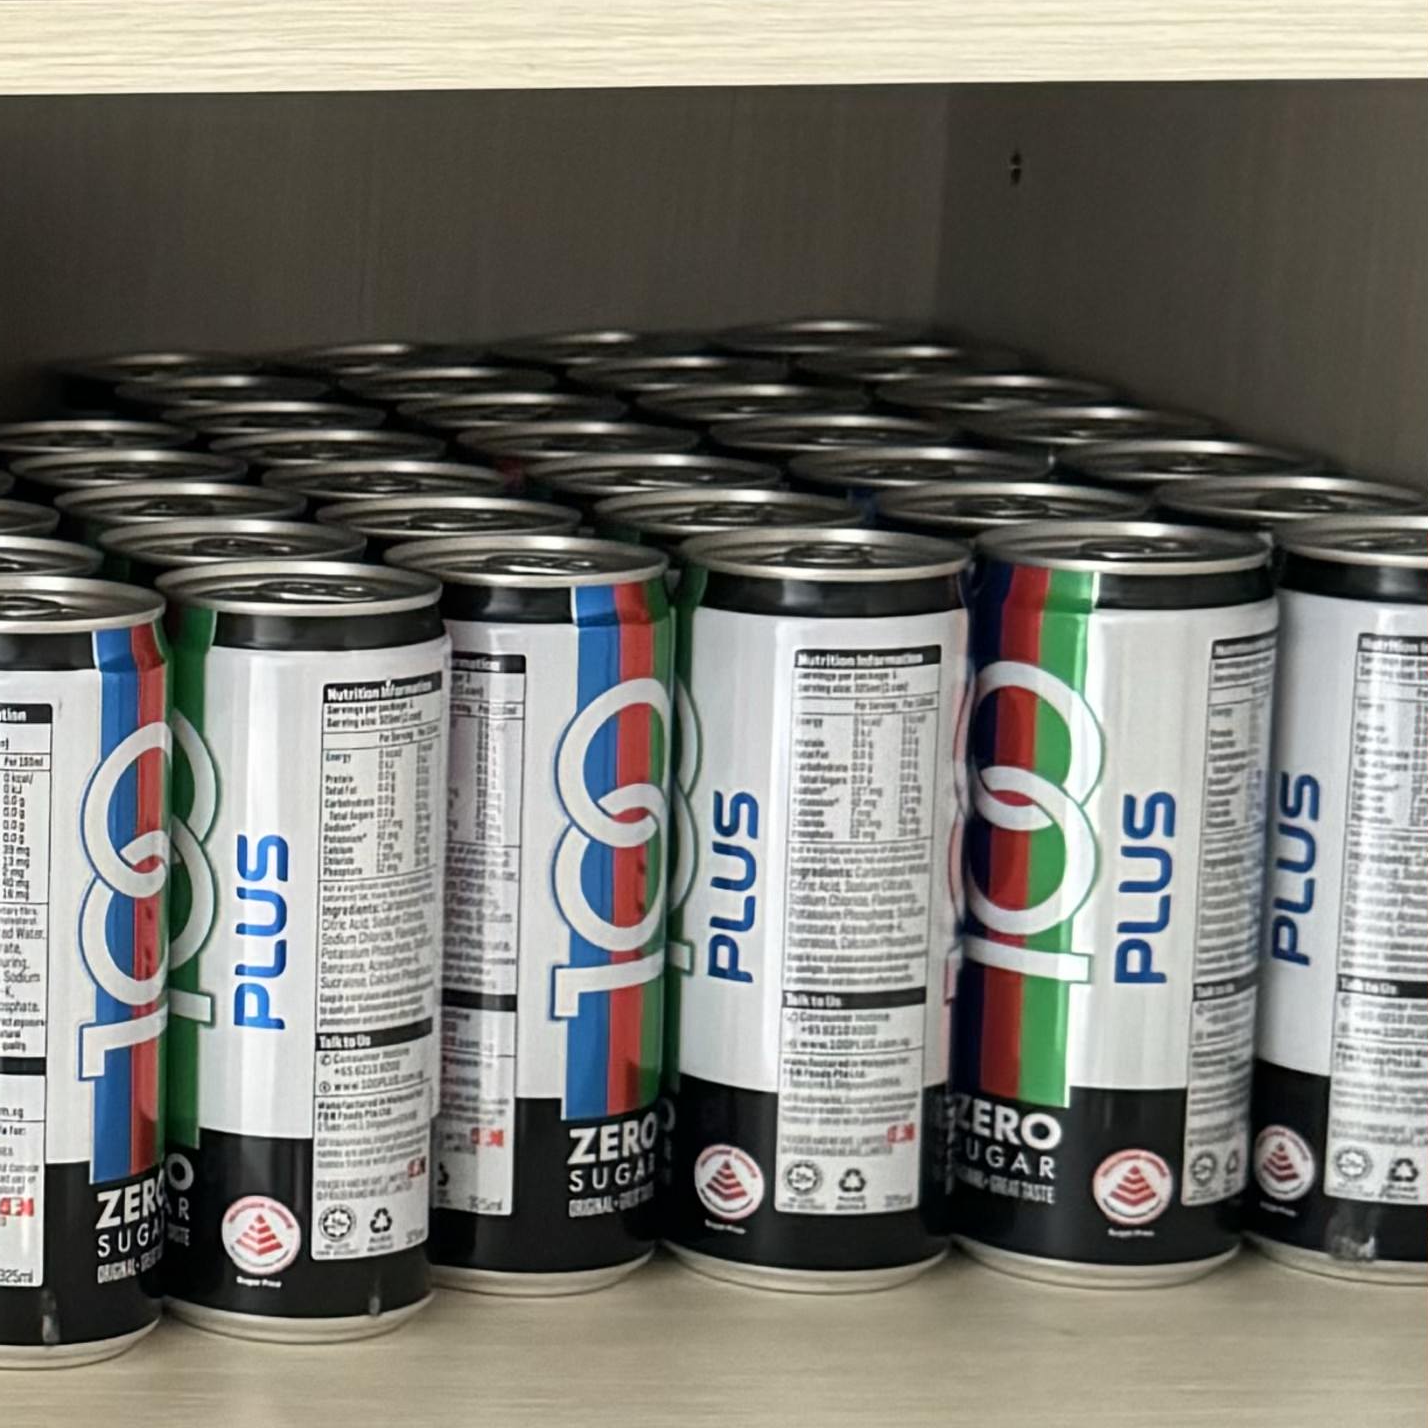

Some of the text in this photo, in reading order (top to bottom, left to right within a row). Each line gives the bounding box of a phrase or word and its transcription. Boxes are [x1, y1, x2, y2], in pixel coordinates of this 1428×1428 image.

[797, 653, 855, 667] Nutrition
[326, 686, 380, 702] Nutrition
[1271, 771, 1322, 967] PLUS
[707, 790, 760, 984] PLUS
[1114, 790, 1177, 984] PLUS
[322, 904, 381, 920] Ingredients:
[234, 833, 290, 1030] PLUS
[3, 970, 41, 984] Sodium
[784, 992, 843, 1008] Talk to Us
[319, 1033, 372, 1049] Talk to Us
[566, 1115, 656, 1166] ZERO
[1020, 1184, 1056, 1206] TASTE
